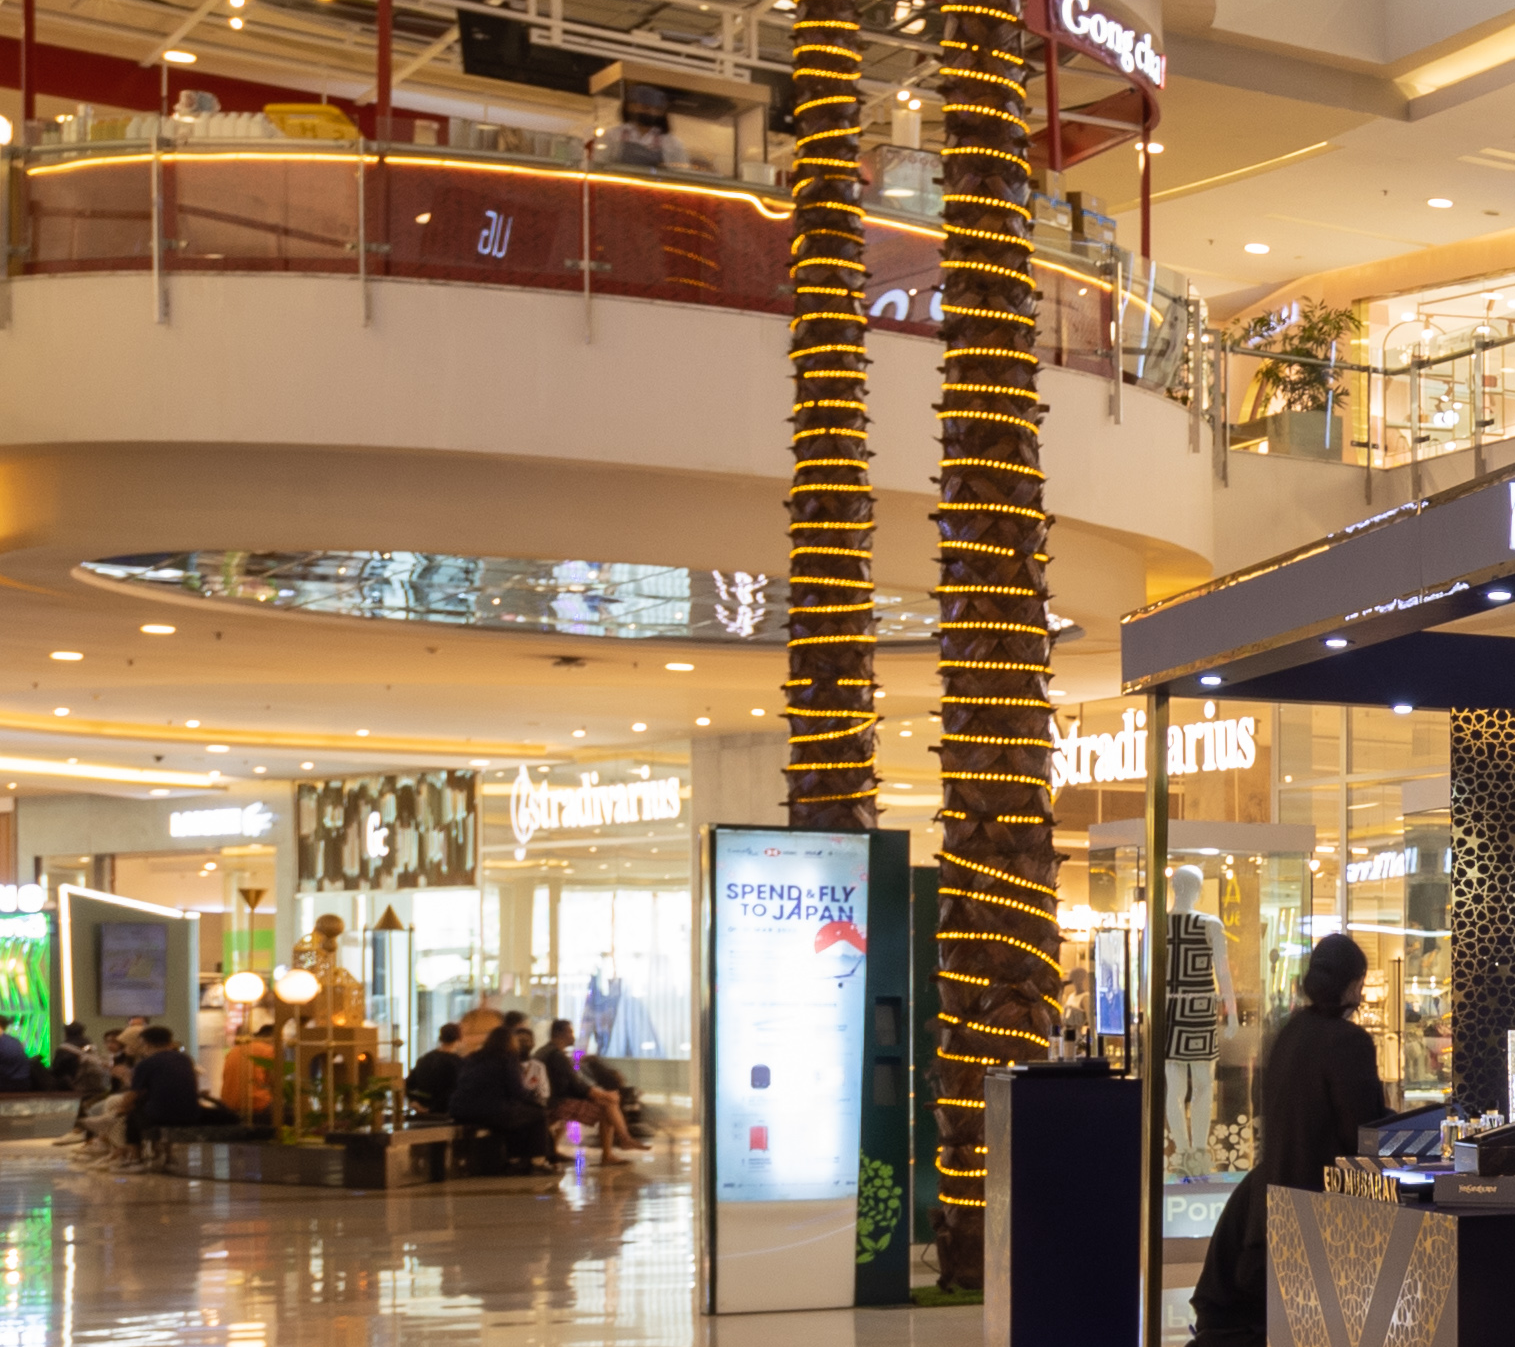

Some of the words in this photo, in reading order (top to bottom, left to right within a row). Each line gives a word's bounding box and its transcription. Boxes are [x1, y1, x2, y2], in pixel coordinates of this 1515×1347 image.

[726, 882, 802, 902] SPEND
[818, 885, 856, 903] FLY
[741, 903, 767, 917] TO
[772, 903, 854, 922] JAPAN
[1324, 1165, 1342, 1193] EID
[1344, 1167, 1399, 1204] MUBARAK
